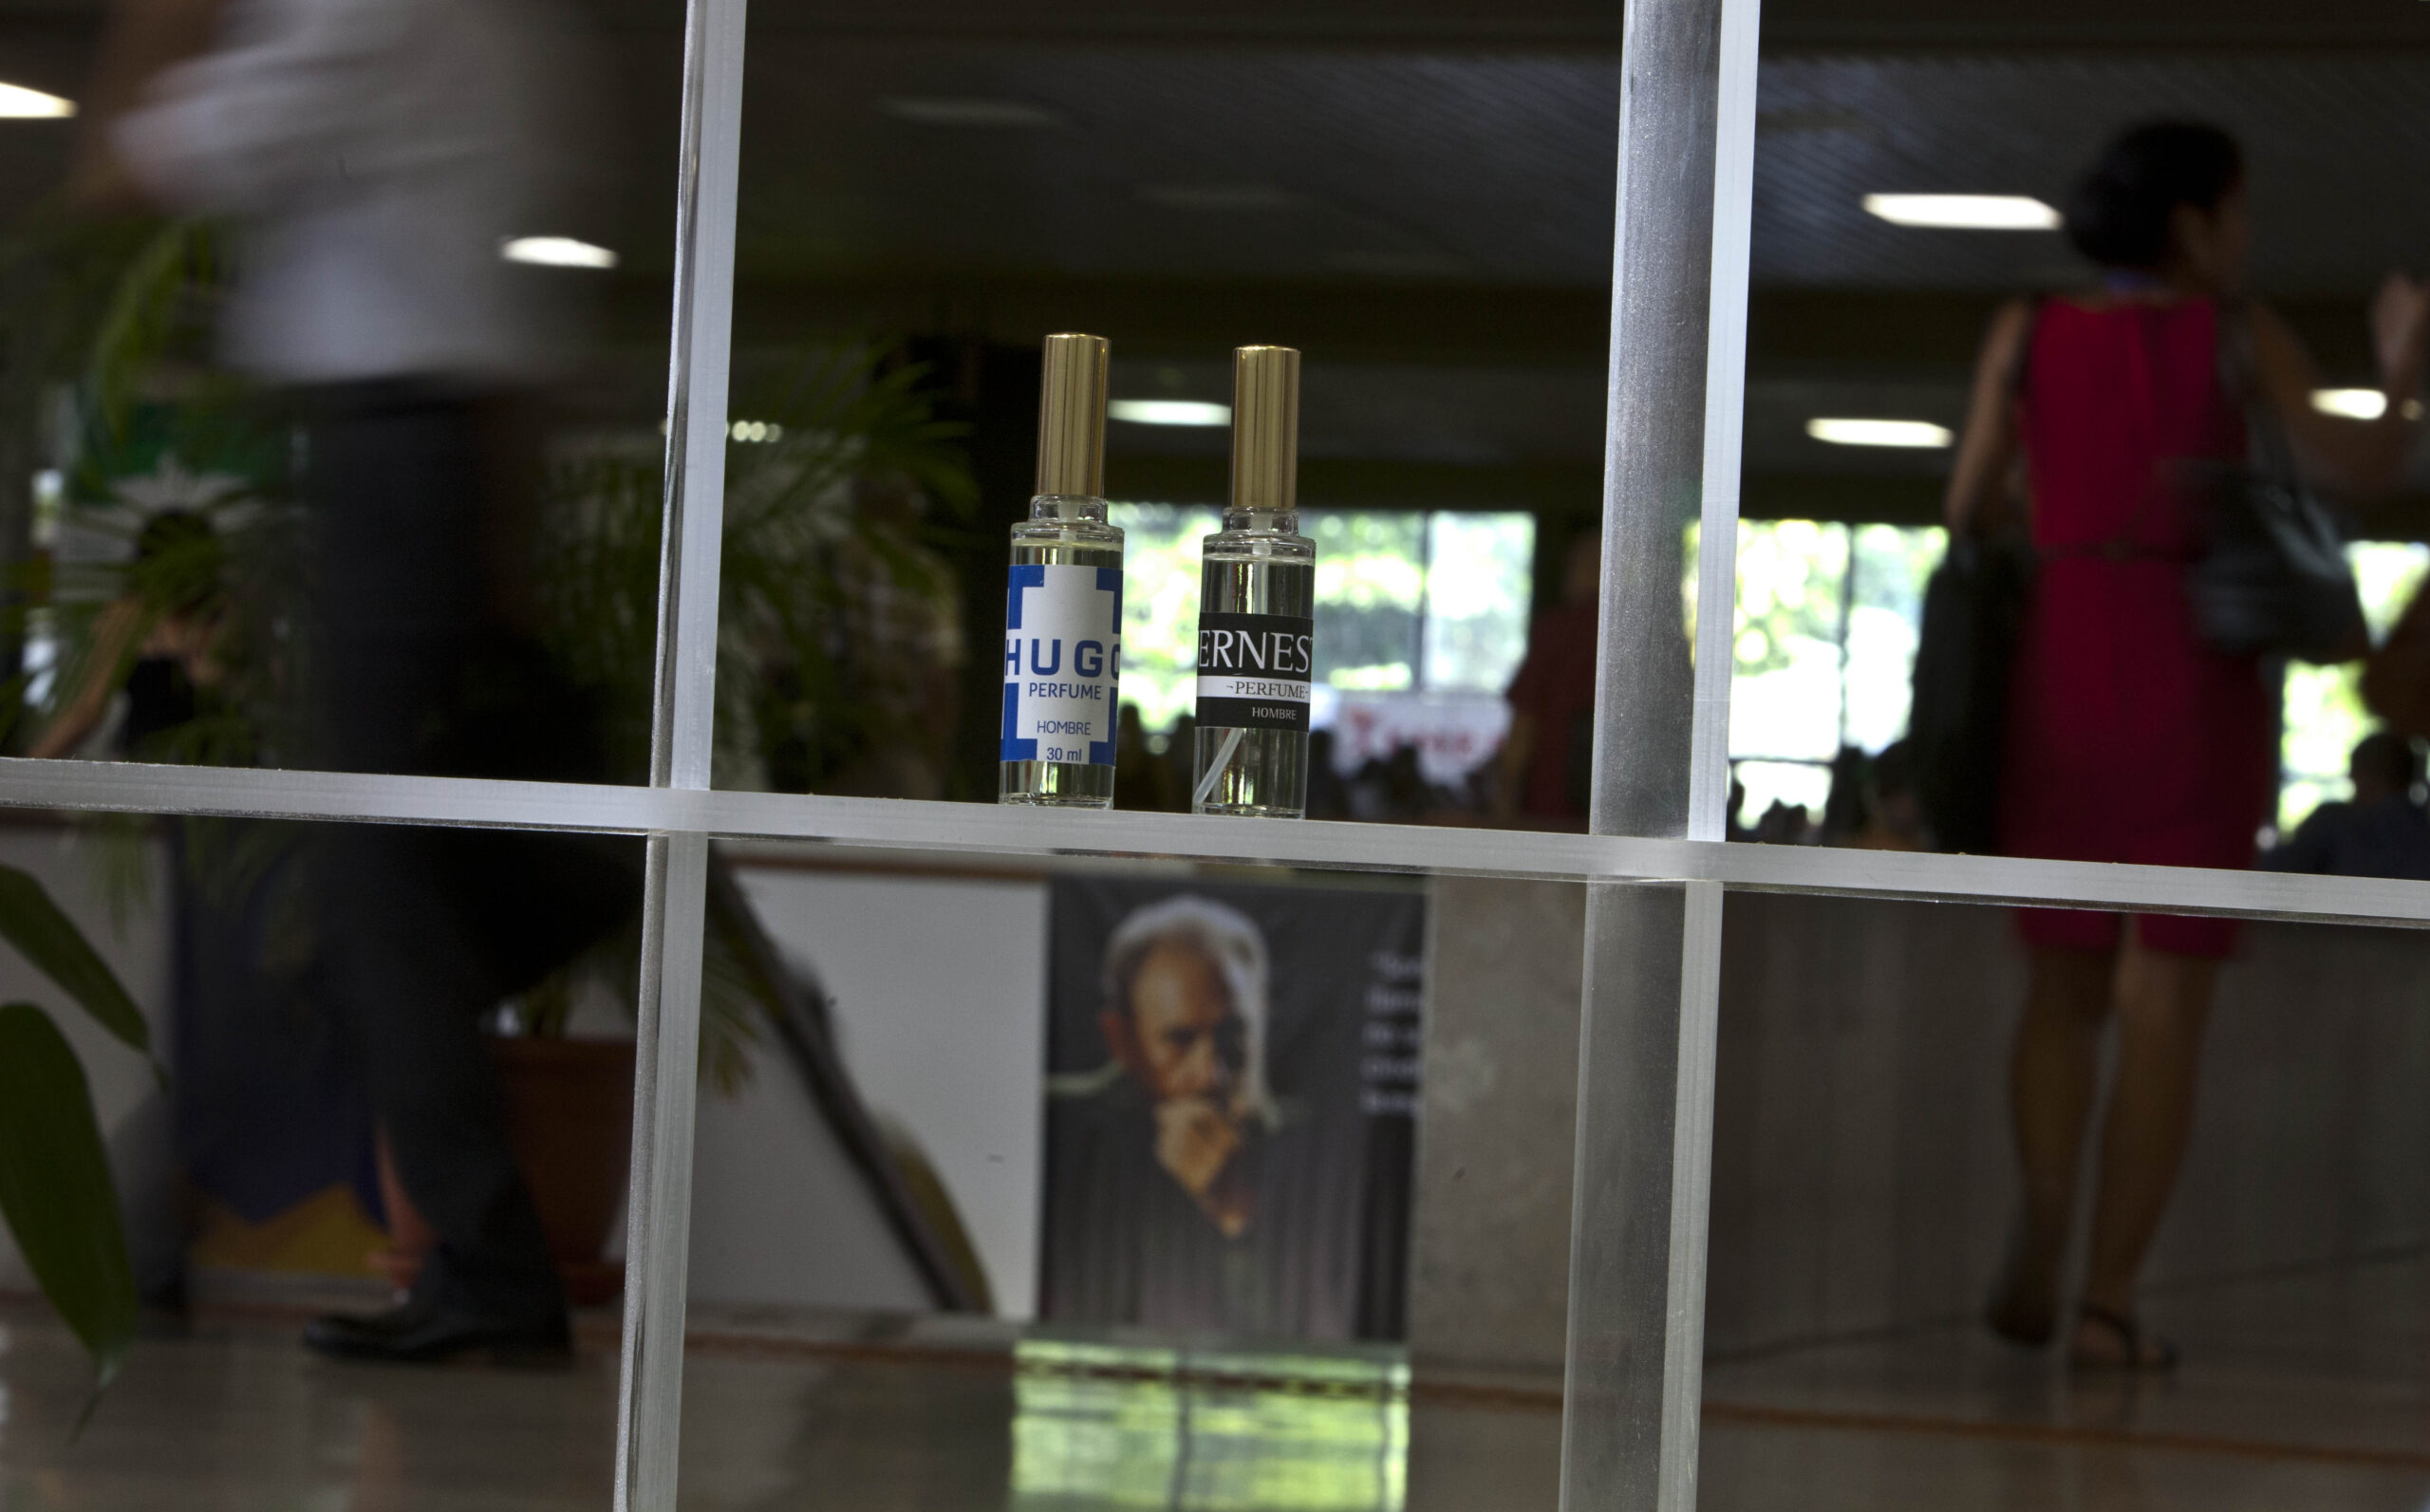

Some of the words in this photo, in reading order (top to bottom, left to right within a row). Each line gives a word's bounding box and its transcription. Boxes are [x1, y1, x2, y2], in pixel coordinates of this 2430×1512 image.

[1199, 630, 1313, 673] ERNES
[1029, 682, 1101, 700] PERFUME
[1252, 707, 1297, 719] HOMBRE
[1037, 720, 1091, 736] HOMBRE
[1046, 747, 1062, 760] 30
[1067, 748, 1081, 761] ml
